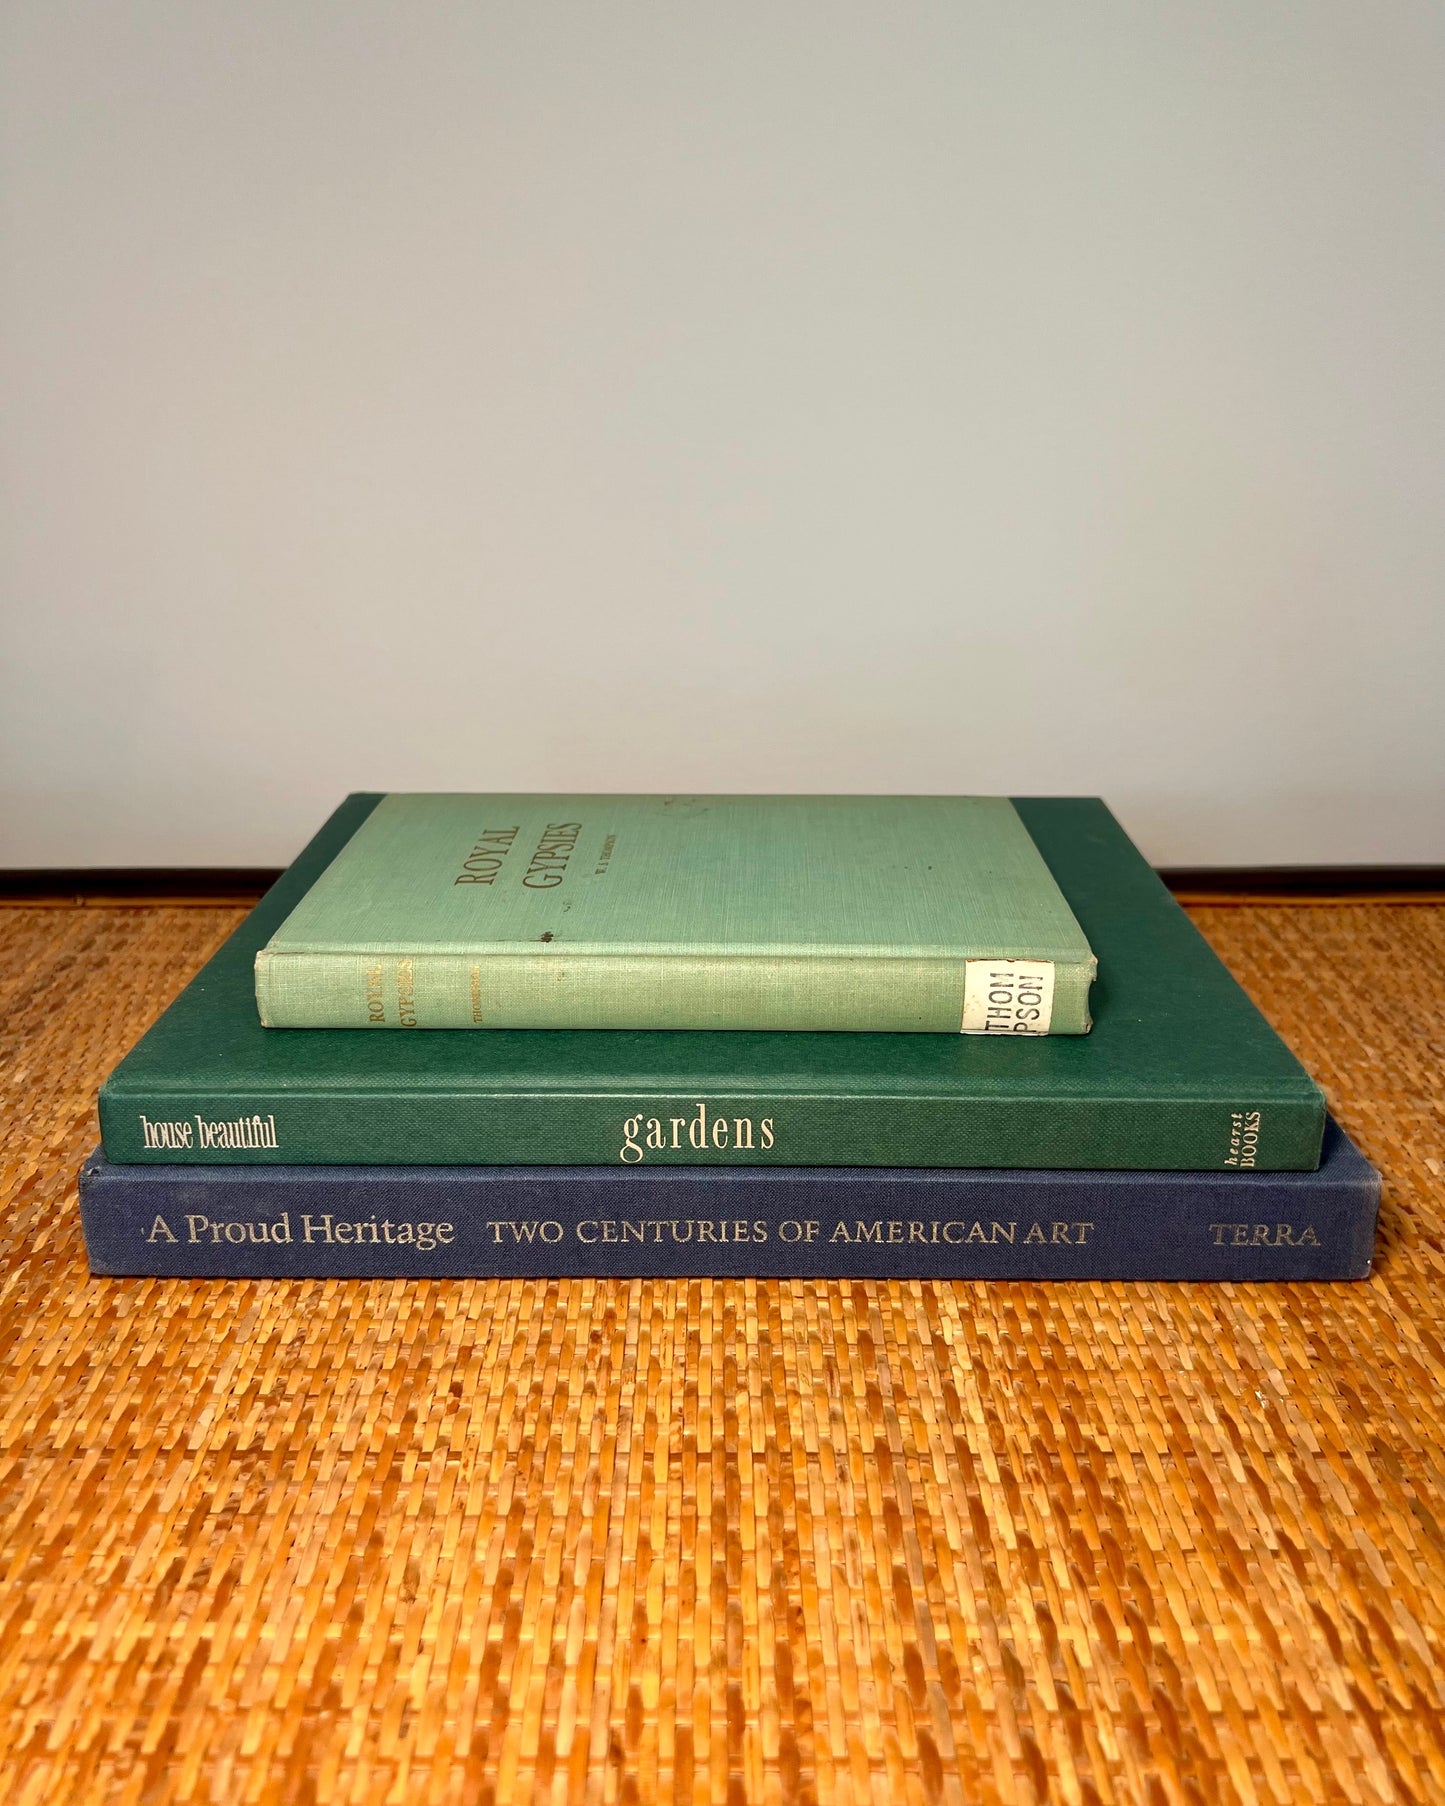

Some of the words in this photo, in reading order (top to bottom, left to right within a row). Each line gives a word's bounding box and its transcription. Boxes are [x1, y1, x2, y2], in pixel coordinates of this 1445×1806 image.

[454, 825, 521, 887] ROYAL
[522, 822, 583, 889] GYPSIES
[366, 963, 386, 1024] ROYAL
[984, 972, 1015, 1031] THOM
[1013, 975, 1044, 1033] PSON
[139, 1114, 194, 1149] house
[194, 1114, 280, 1149] beautiful
[619, 1103, 775, 1164] gardens
[1224, 1112, 1243, 1166] hearst
[1240, 1110, 1261, 1168] BOOKS
[146, 1214, 179, 1243] A
[185, 1212, 293, 1244] Proud
[301, 1214, 456, 1251] Heritage
[486, 1220, 565, 1244] TWO
[575, 1219, 769, 1244] CENTURIES
[777, 1219, 821, 1244] OF
[828, 1219, 1018, 1245] AMERICAN
[1023, 1220, 1095, 1245] ART
[1208, 1222, 1322, 1247] TERRA
